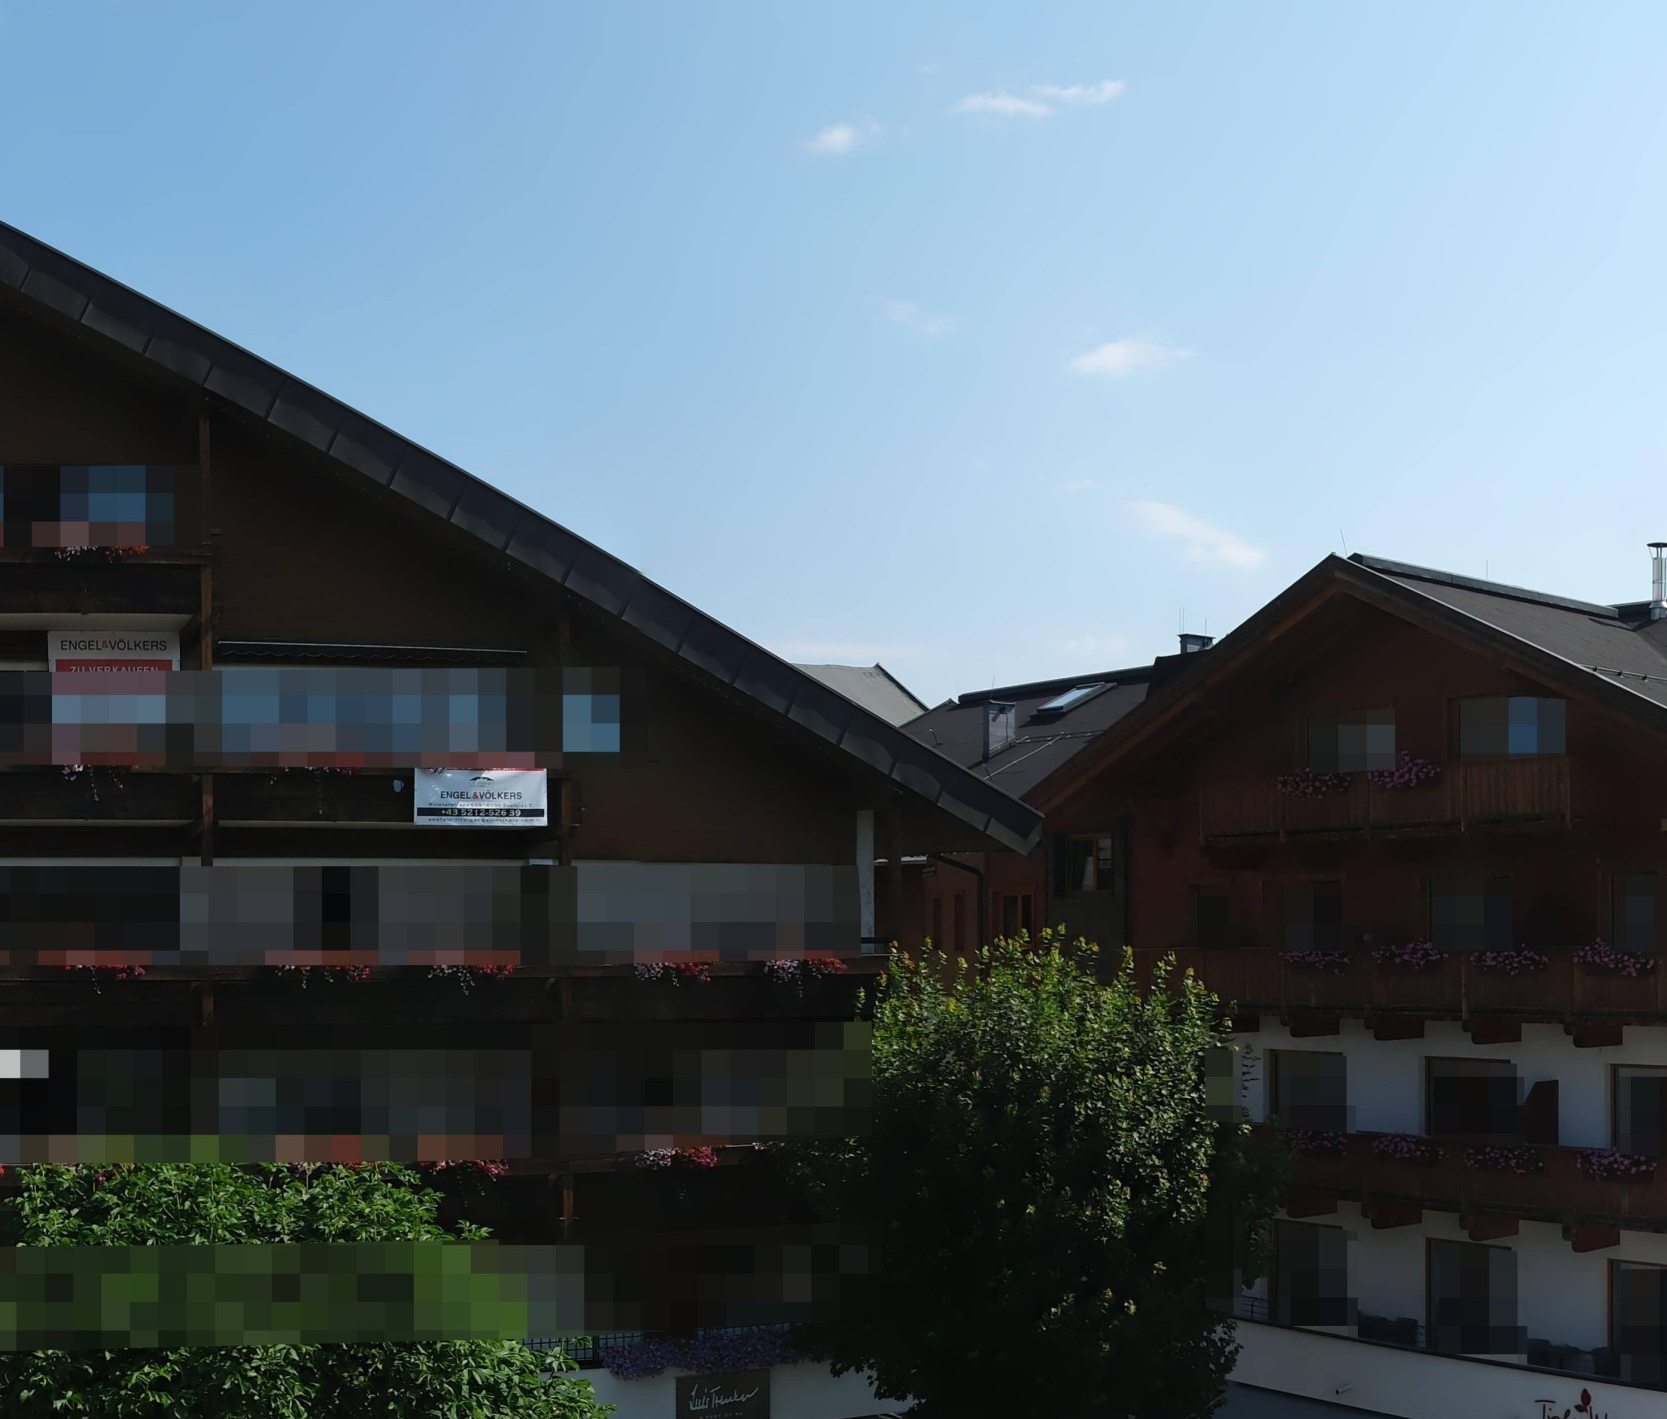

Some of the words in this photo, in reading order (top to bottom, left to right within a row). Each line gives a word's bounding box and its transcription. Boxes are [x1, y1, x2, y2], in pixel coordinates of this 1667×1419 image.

[60, 638, 168, 651] ENGEL&VÖLKERS
[440, 790, 522, 800] ENGEL&VÖLKERS
[441, 808, 458, 816] +43
[508, 809, 522, 817] 39
